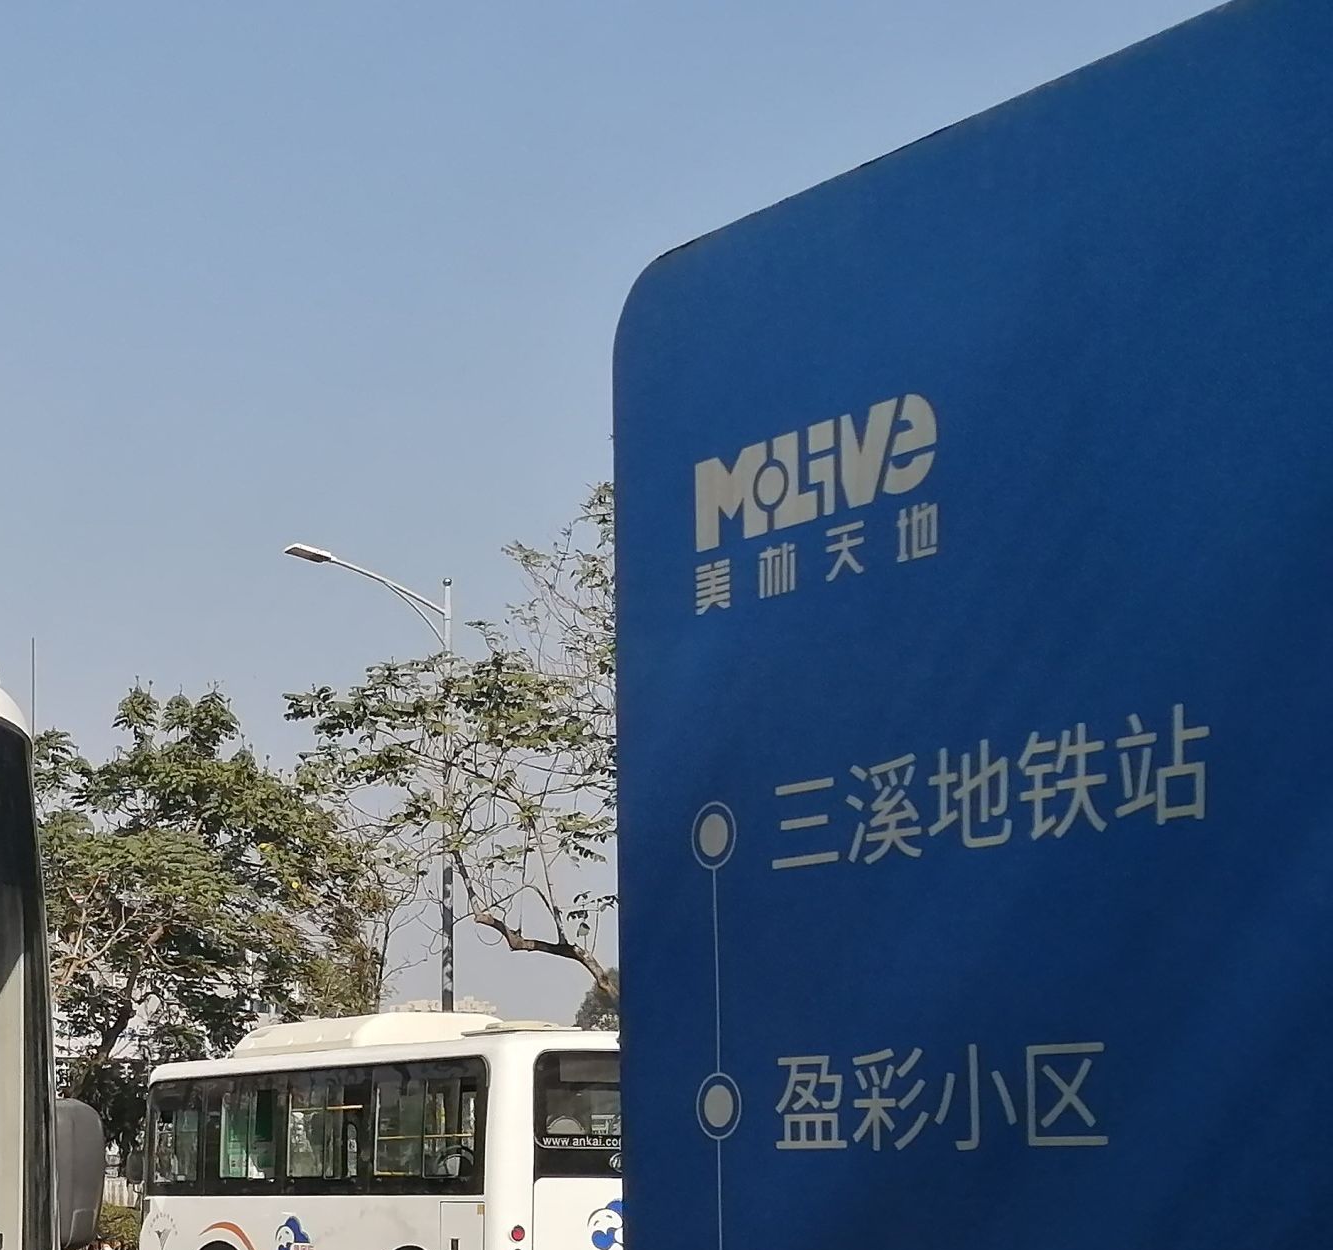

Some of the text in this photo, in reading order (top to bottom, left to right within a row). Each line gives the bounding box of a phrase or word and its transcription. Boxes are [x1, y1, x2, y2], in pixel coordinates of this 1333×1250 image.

[694, 501, 939, 616] 美林天地
[771, 702, 1211, 871] 三溪地铁站
[542, 1134, 621, 1147] www.ankai.co
[775, 1041, 1109, 1152] 盈彩小区
